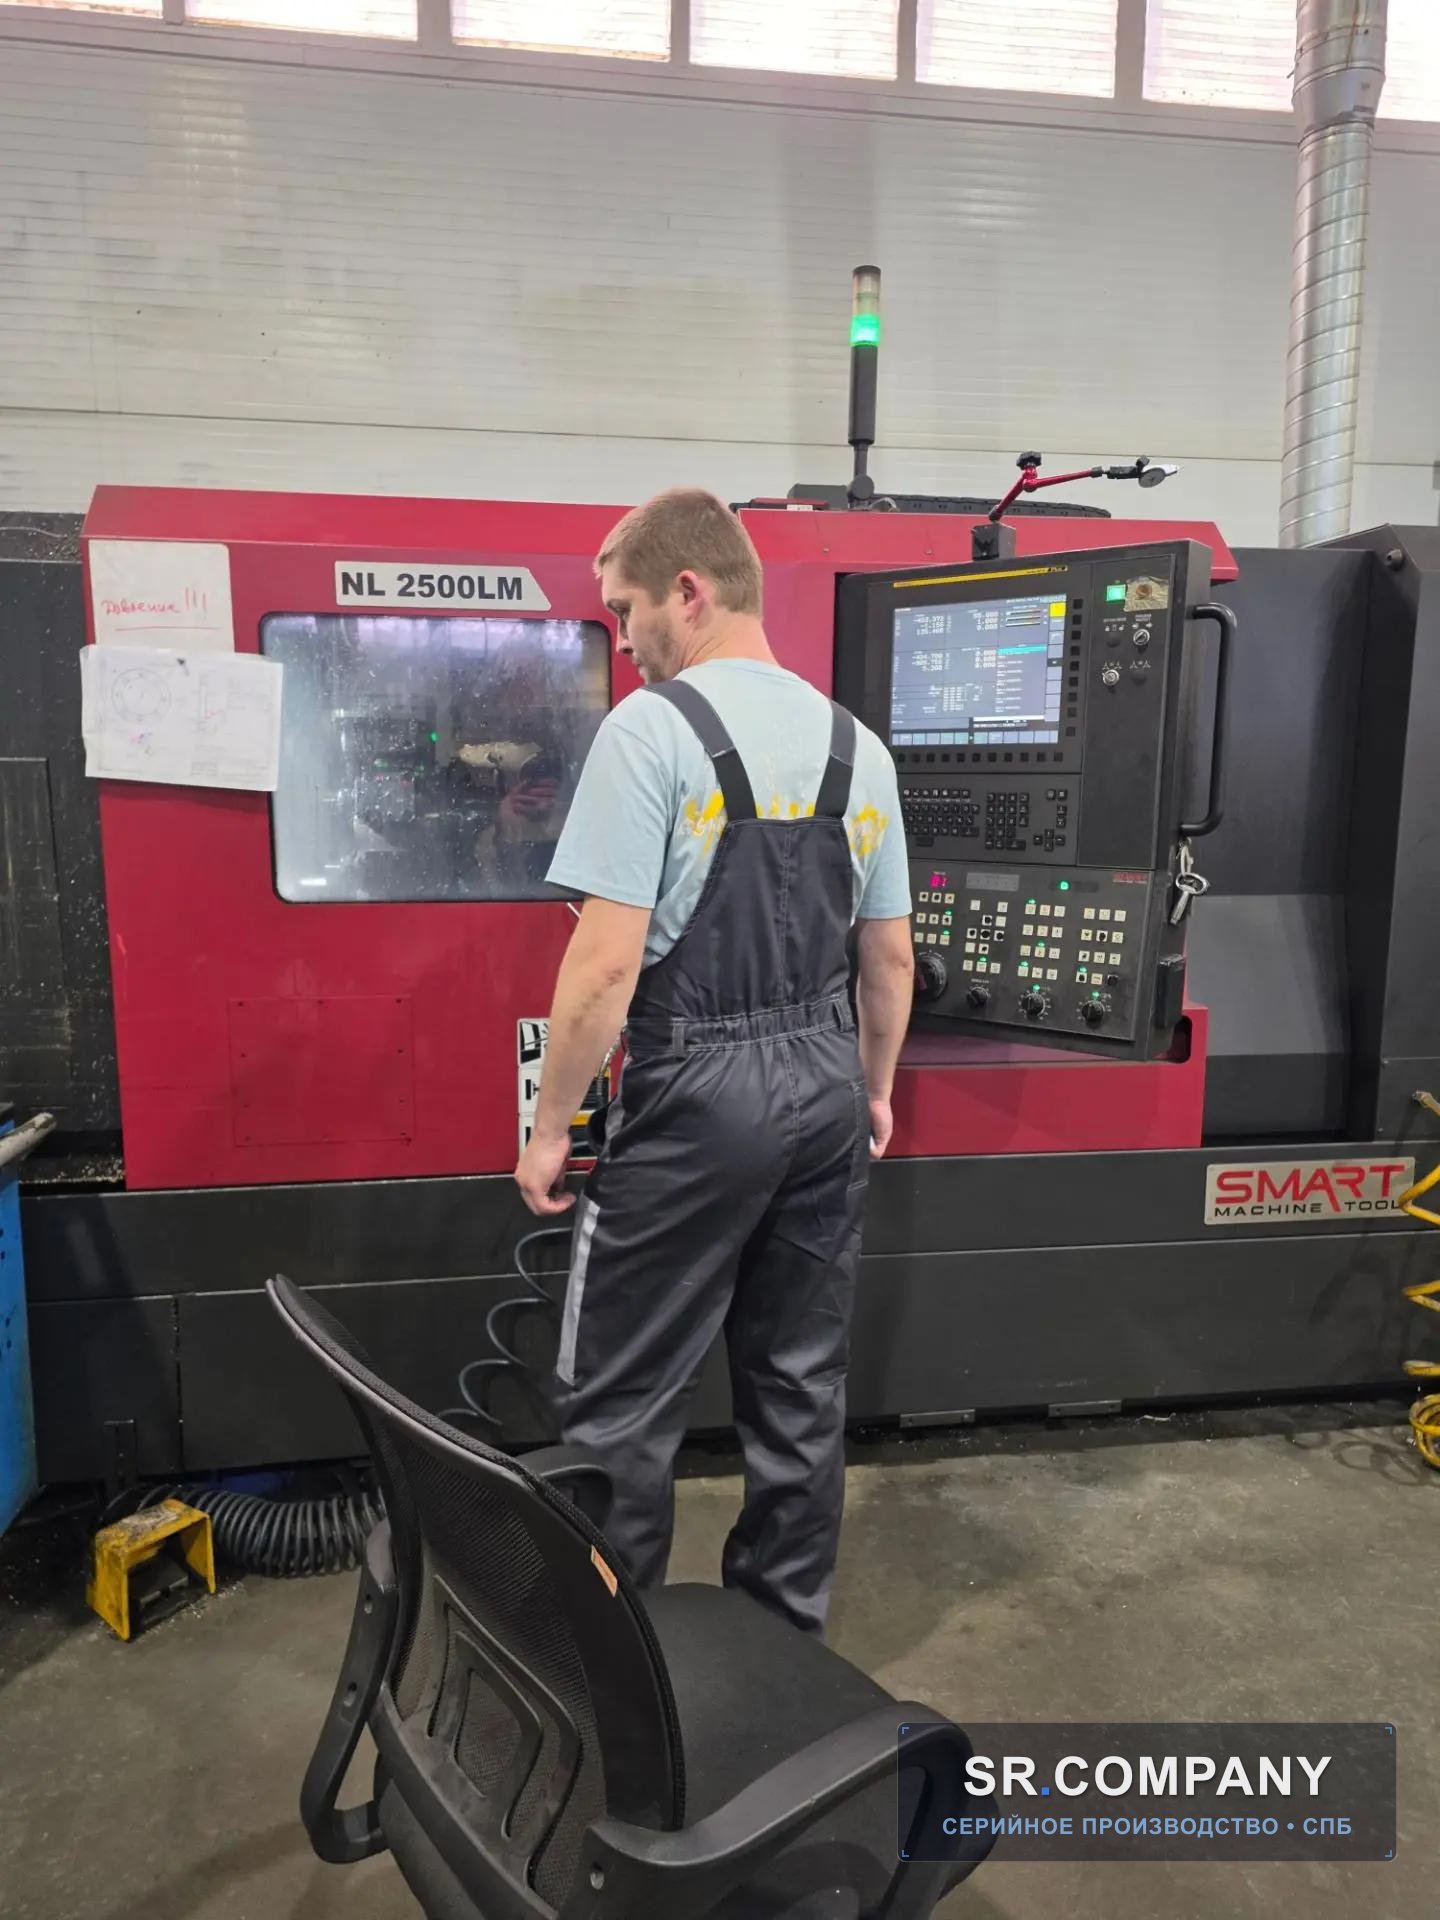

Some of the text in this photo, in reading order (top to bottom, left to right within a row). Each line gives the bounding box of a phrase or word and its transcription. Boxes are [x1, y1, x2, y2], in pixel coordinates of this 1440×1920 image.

[341, 571, 523, 601] NL 2500LM
[1215, 1164, 1405, 1213] SMART
[1214, 1199, 1400, 1217] MACHINE TOOL
